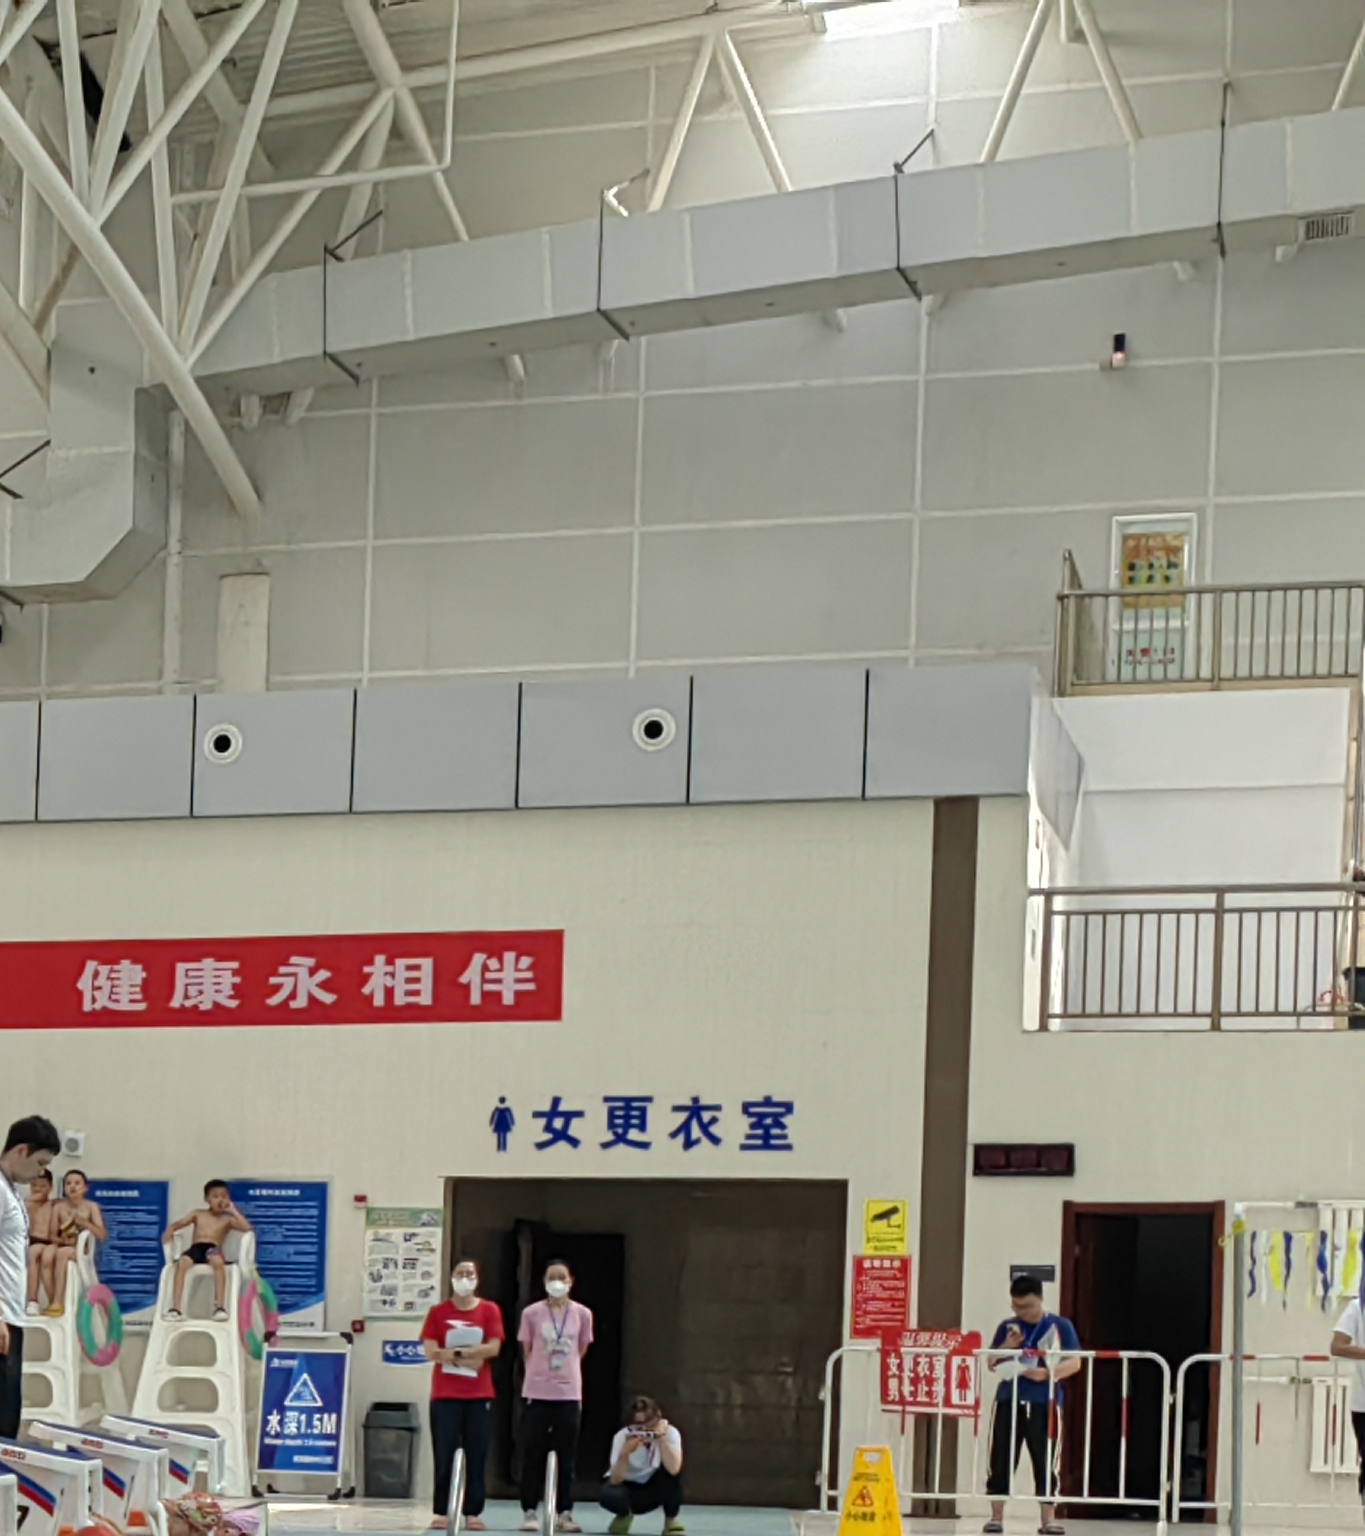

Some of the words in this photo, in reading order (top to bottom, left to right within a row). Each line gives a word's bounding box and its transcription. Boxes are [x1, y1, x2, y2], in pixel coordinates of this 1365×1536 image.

[75, 951, 538, 1012] 健康永相伴
[531, 1096, 795, 1152] 女更衣室
